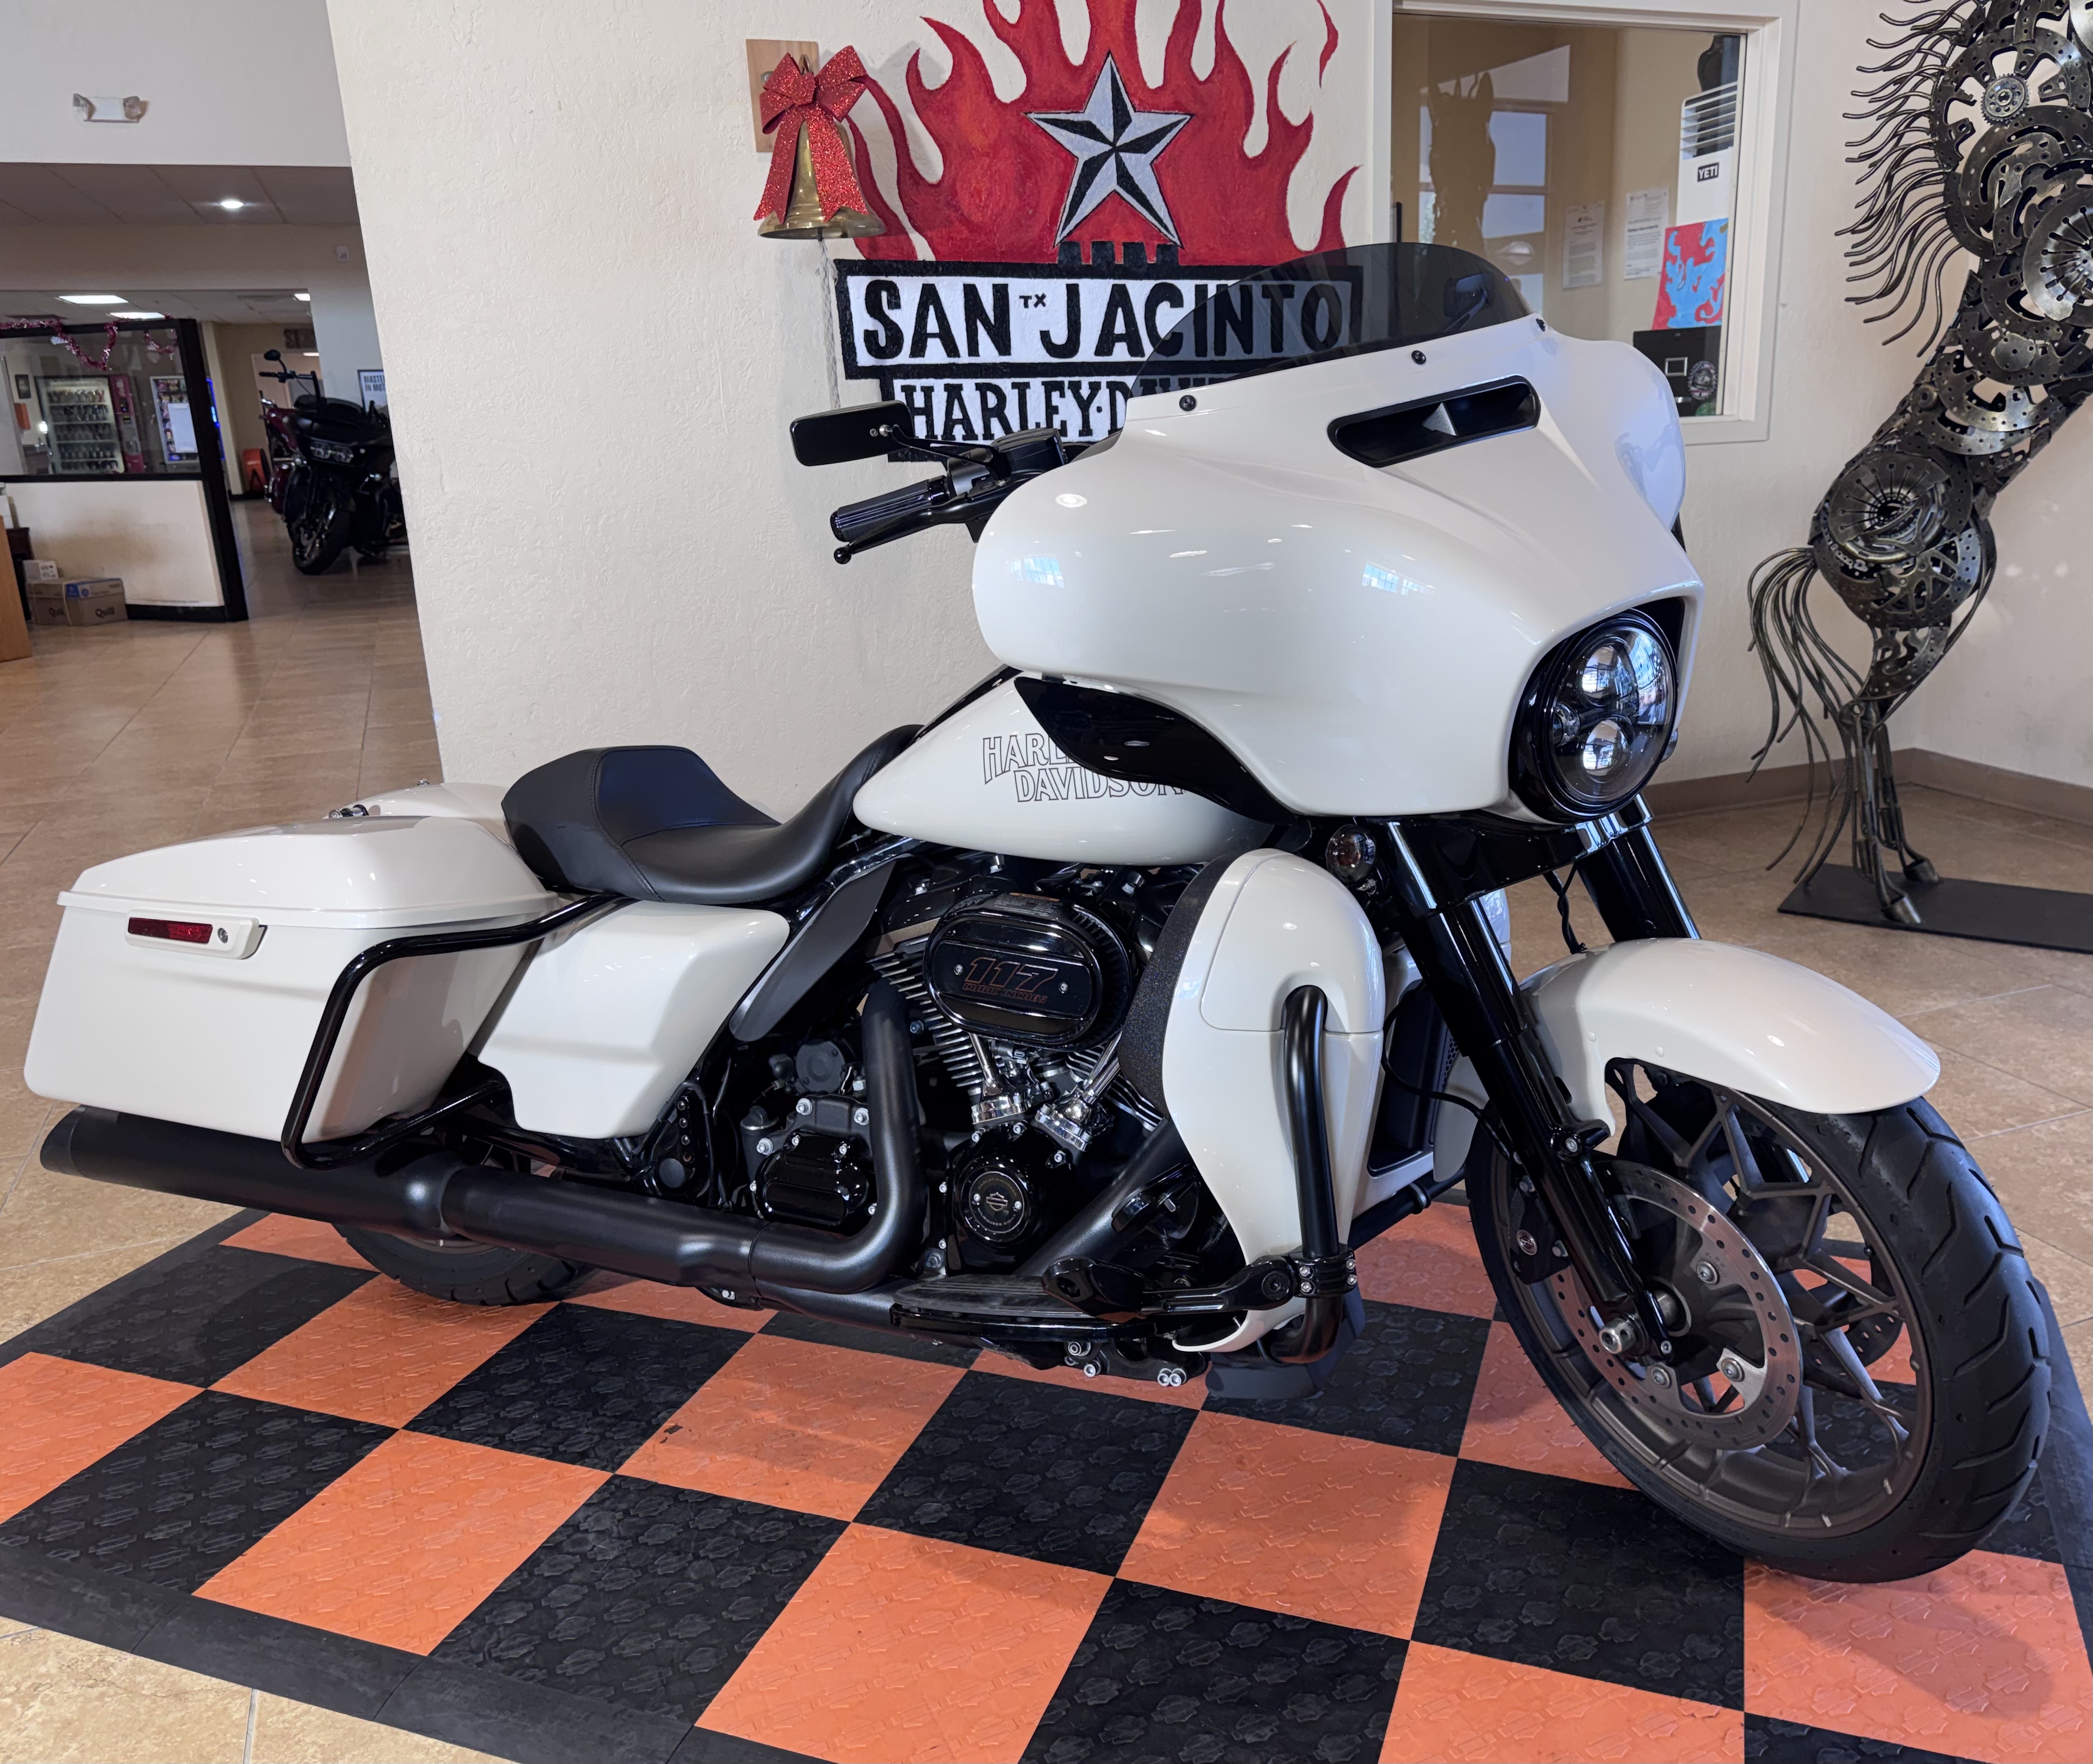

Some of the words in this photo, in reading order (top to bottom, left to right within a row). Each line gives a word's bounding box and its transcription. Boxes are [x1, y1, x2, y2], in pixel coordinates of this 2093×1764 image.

[1698, 165, 1718, 179] YETI
[864, 280, 1011, 359] SAN
[1020, 293, 1047, 308] TX
[1039, 281, 1343, 359] JACINTO
[363, 375, 385, 383] MASTE
[96, 606, 115, 618] Quill
[983, 733, 1079, 785] HARL
[964, 957, 1059, 993] 117
